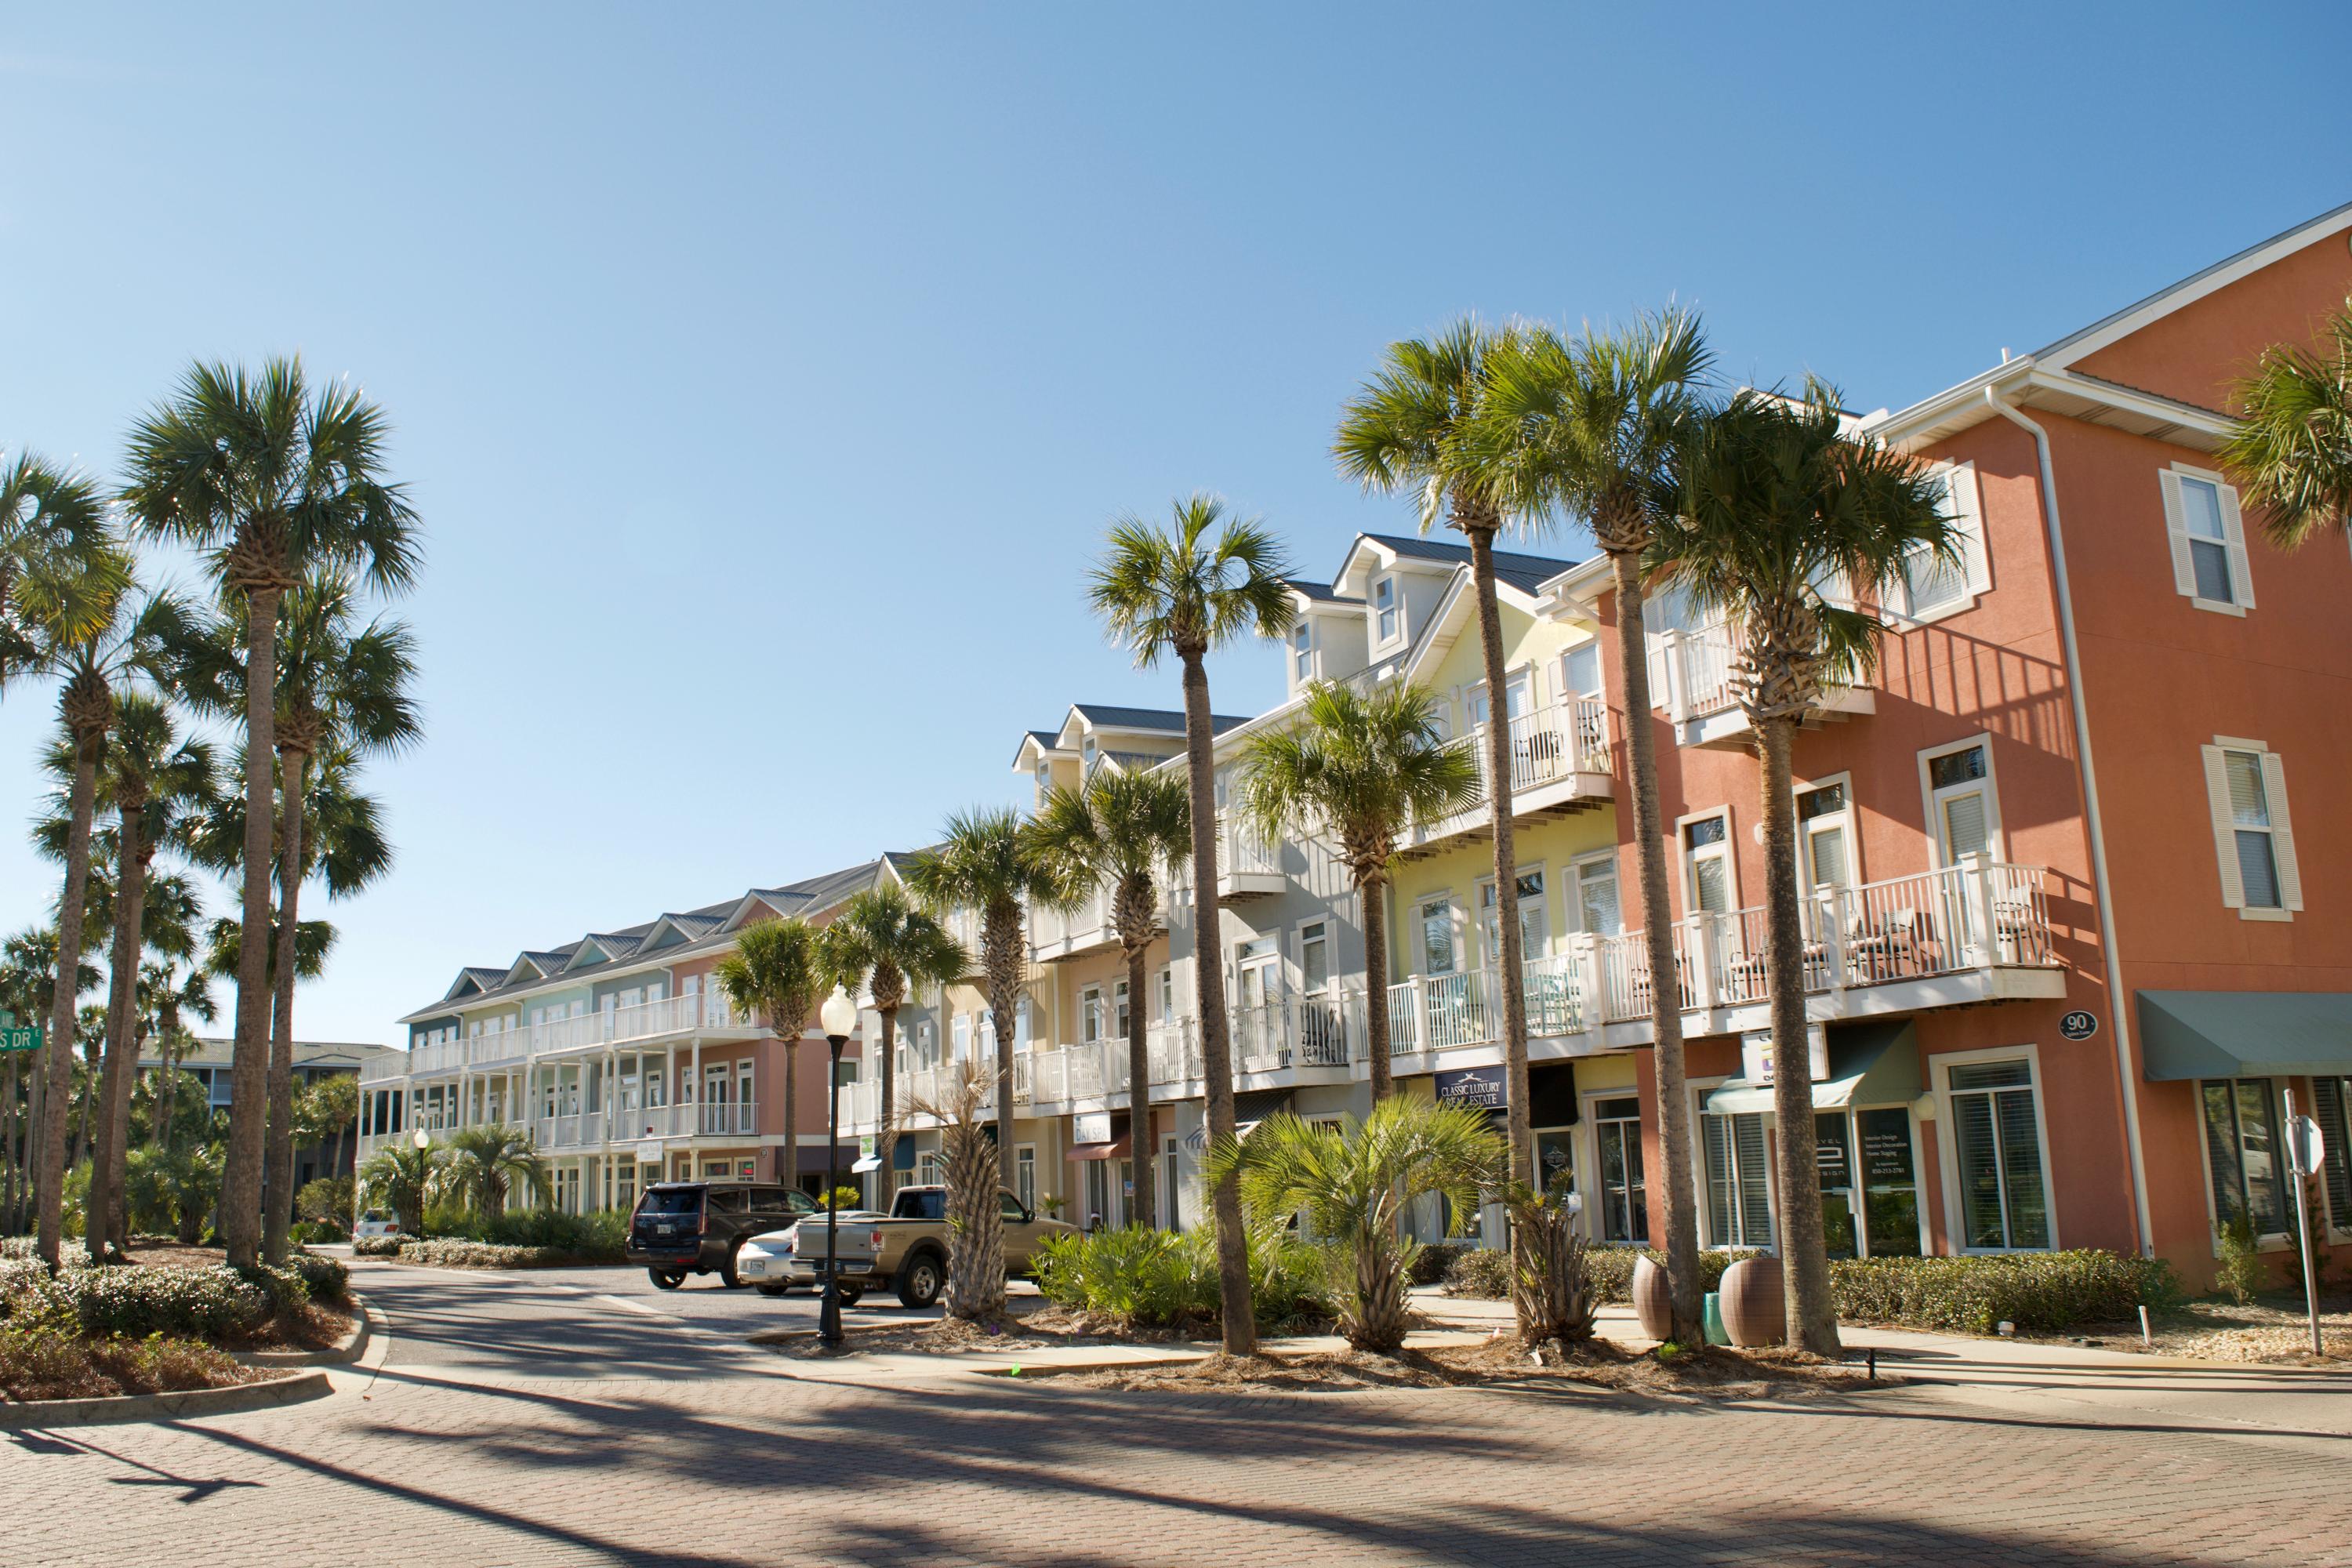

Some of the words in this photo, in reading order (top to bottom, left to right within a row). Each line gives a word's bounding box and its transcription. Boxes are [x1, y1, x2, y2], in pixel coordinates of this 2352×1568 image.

[0, 1014, 14, 1029] ANE
[2067, 1014, 2086, 1030] 90
[13, 1032, 31, 1047] DR
[35, 1029, 40, 1037] E
[1441, 1085, 1468, 1097] CLASSIC
[1470, 1082, 1501, 1094] LUXURY
[1469, 1094, 1497, 1105] ESTATE
[1076, 1128, 1090, 1142] DAY
[1092, 1127, 1107, 1141] SPA
